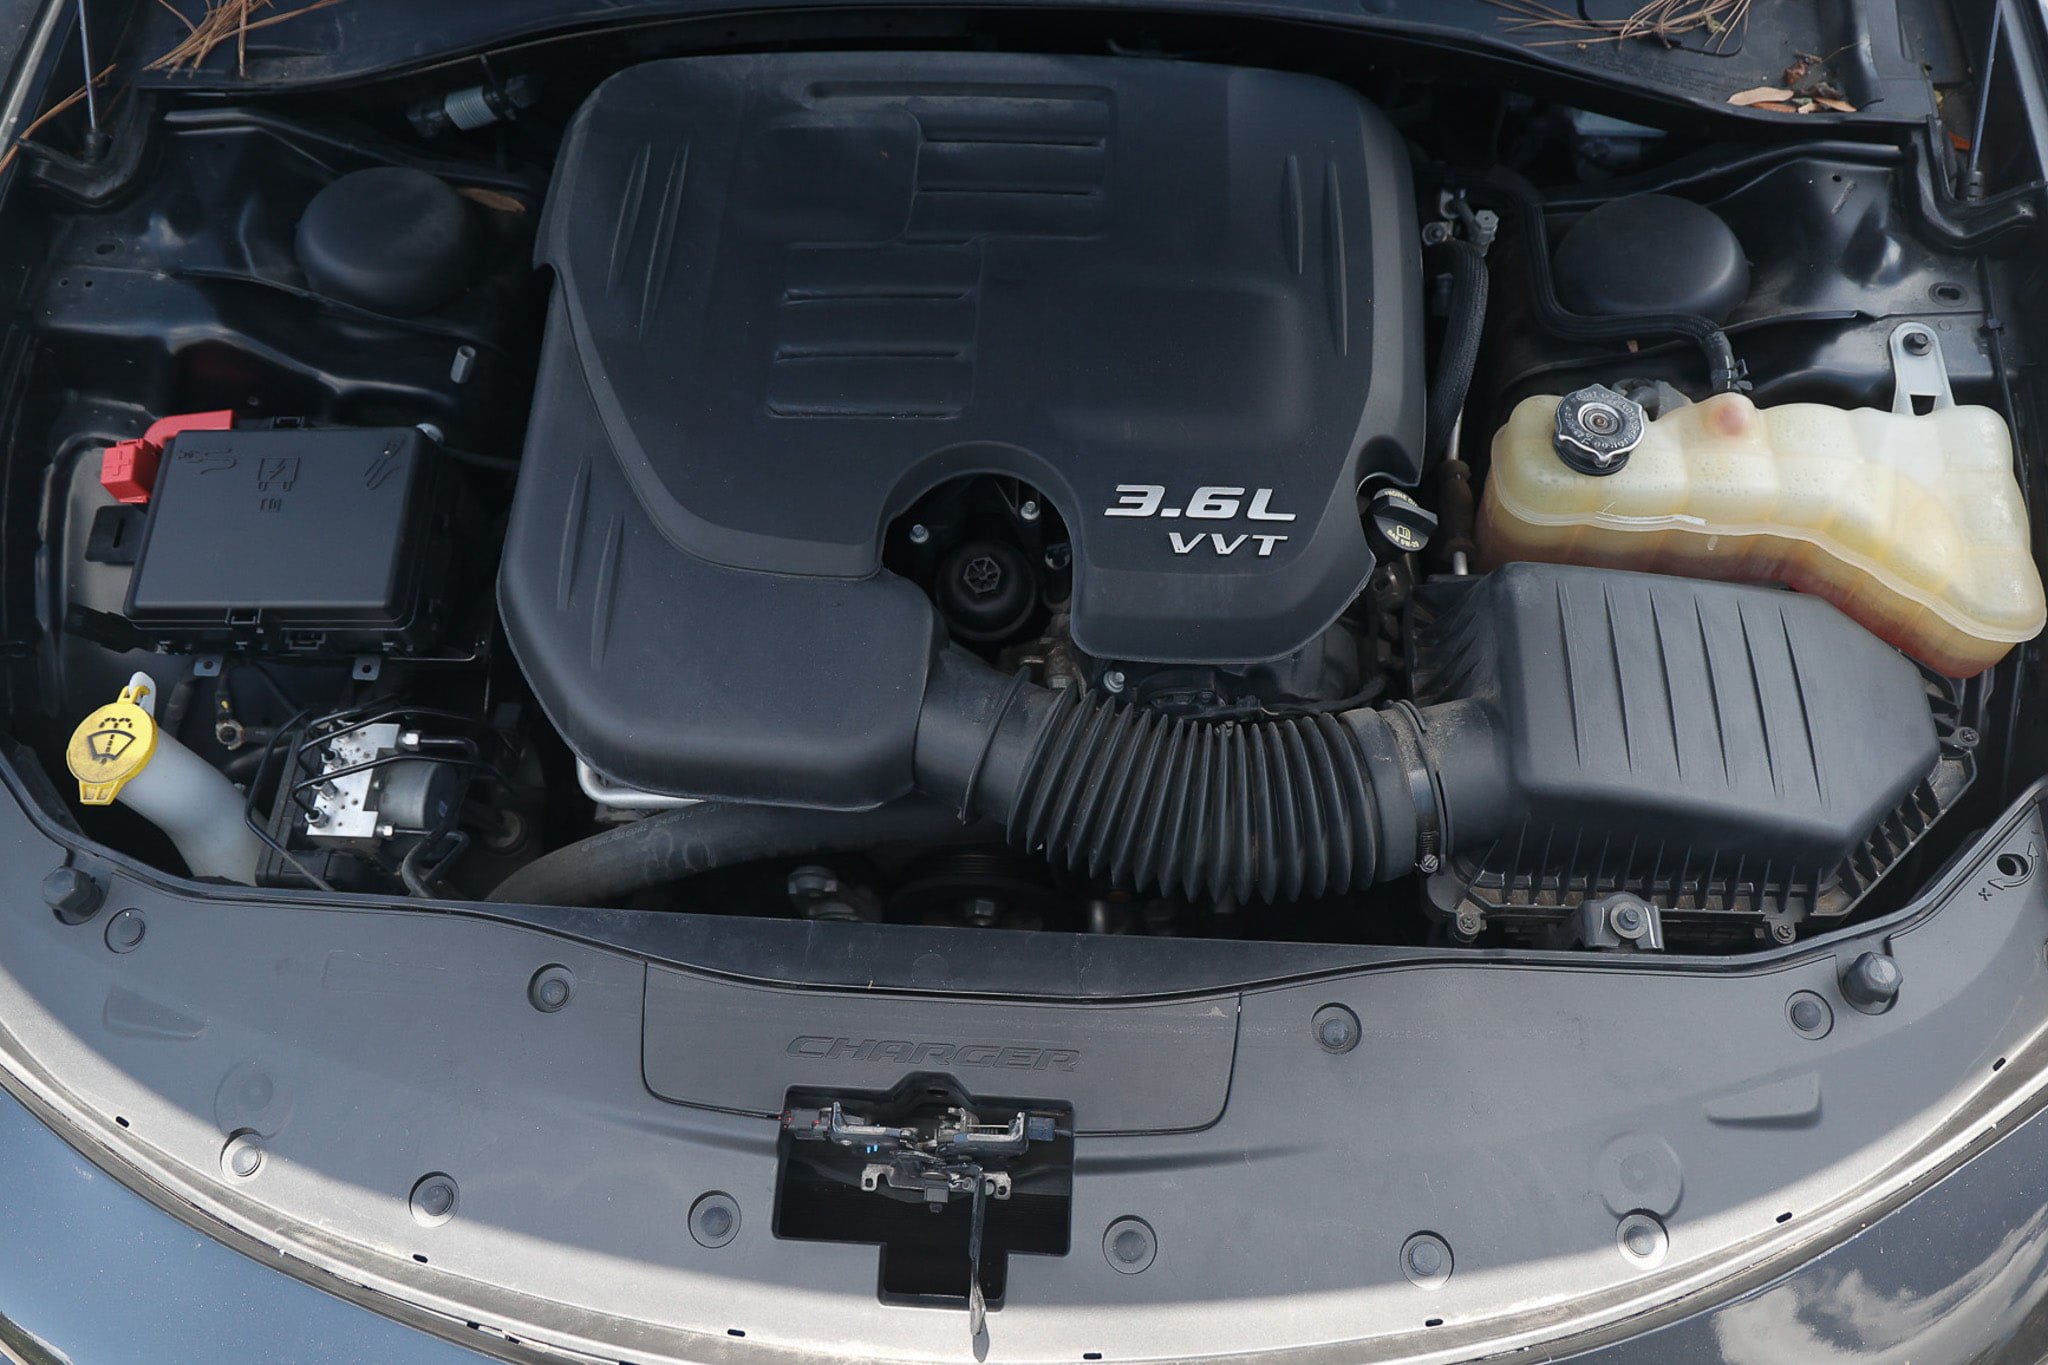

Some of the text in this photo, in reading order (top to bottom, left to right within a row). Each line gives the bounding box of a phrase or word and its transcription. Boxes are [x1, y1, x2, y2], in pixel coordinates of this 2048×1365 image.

[1103, 485, 1297, 521] 3.6L
[1169, 532, 1289, 556] VVT
[787, 1036, 1081, 1072] CHARGER
